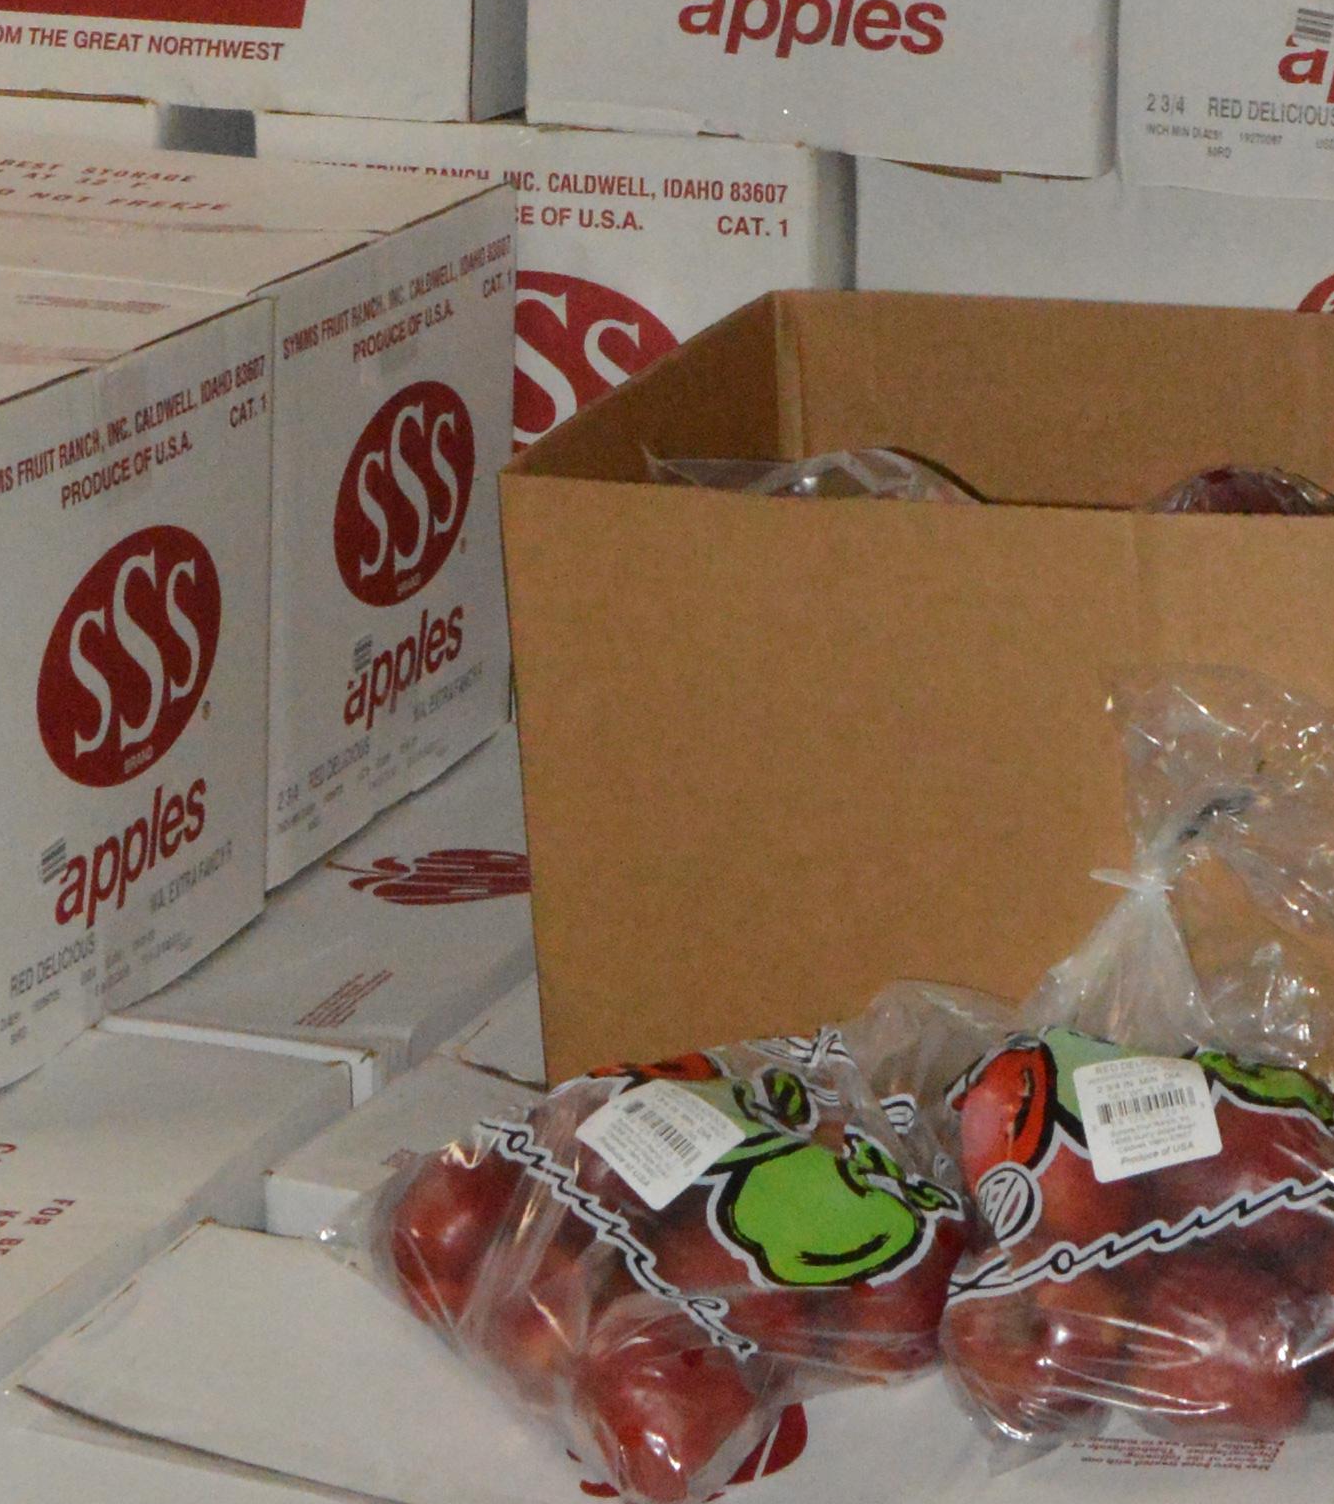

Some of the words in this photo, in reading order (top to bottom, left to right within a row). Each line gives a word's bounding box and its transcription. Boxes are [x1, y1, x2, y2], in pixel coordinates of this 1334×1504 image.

[28, 26, 68, 48] THE
[72, 29, 144, 52] GREAT
[147, 34, 284, 61] NORTHWEST
[1207, 96, 1243, 119] RED
[357, 403, 460, 576] SSS
[69, 547, 198, 758] SSS
[343, 603, 464, 731] apples
[54, 777, 208, 926] apples
